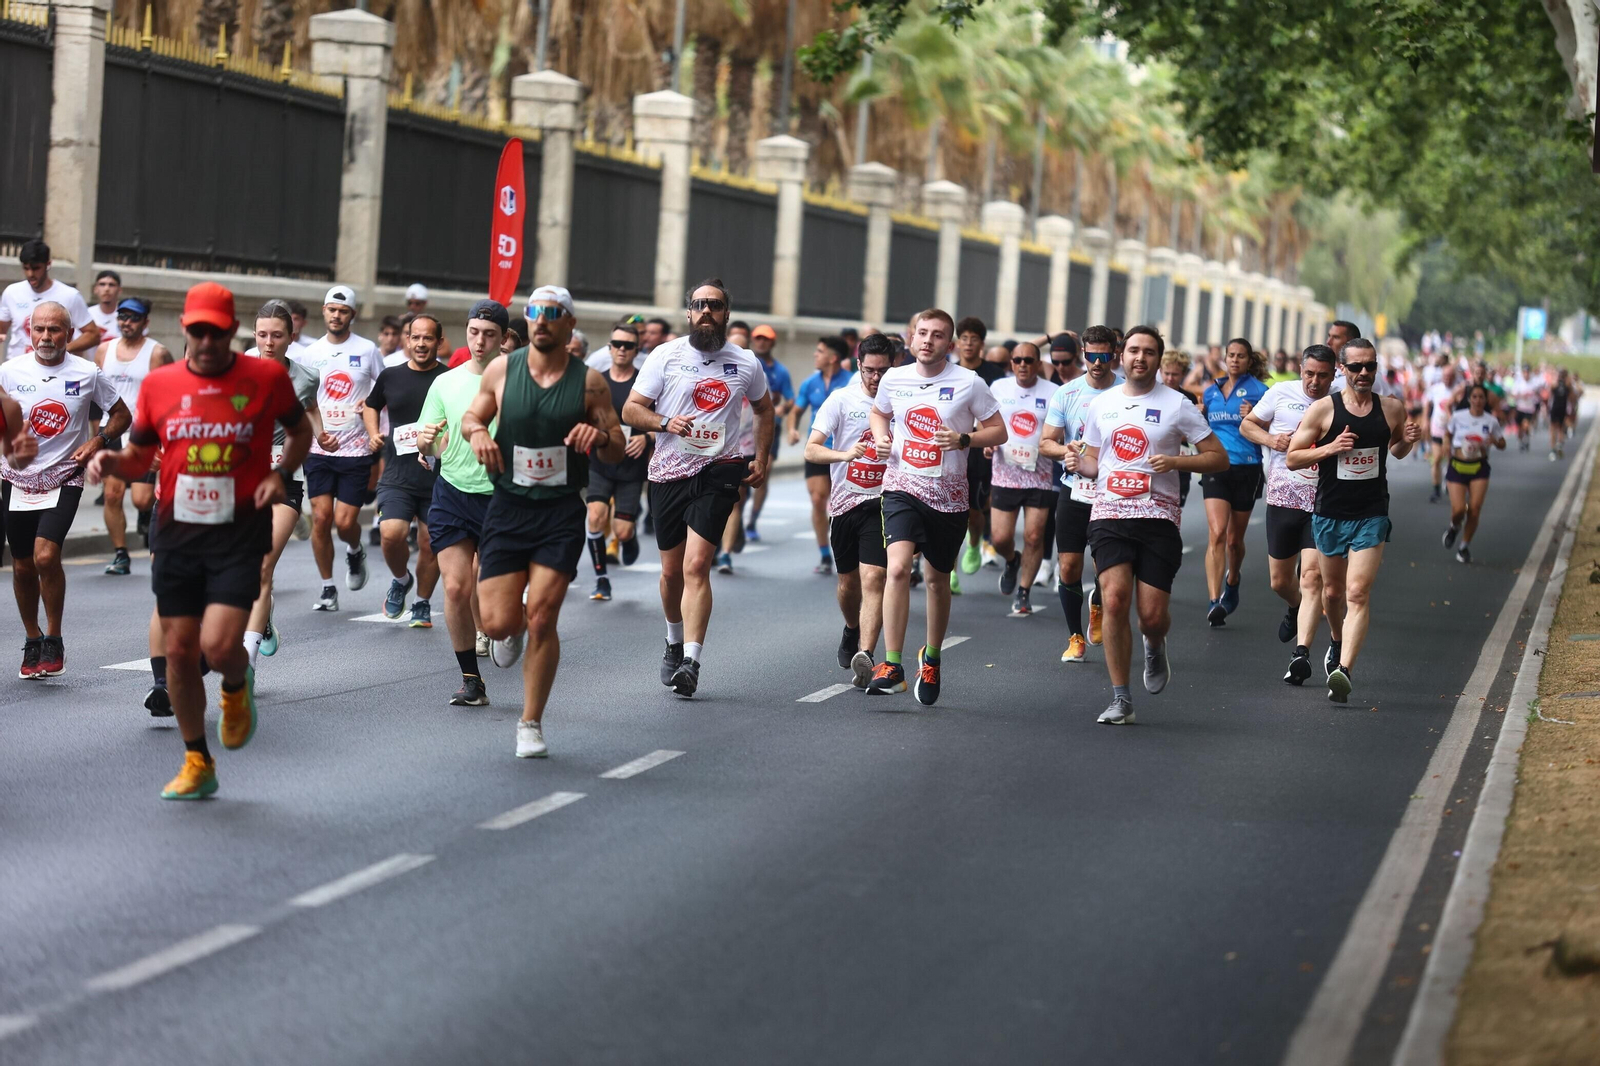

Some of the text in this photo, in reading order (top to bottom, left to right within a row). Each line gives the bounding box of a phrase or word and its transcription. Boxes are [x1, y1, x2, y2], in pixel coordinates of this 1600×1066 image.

[326, 382, 349, 394] FRENO
[328, 377, 350, 389] PONLE
[699, 384, 727, 399] PONLE
[36, 408, 64, 422] PONLE
[326, 410, 346, 418] 551
[910, 412, 938, 426] PONLE
[34, 416, 62, 430] FRENO
[908, 419, 936, 433] FRENO
[1012, 421, 1033, 433] FRENO
[1014, 415, 1035, 427] PONLE
[685, 429, 719, 440] 1156
[1116, 432, 1144, 447] PONLE
[1011, 449, 1031, 457] 959
[1115, 440, 1141, 454] FRENO
[905, 447, 937, 460] 2606
[527, 458, 553, 469] 141
[1344, 455, 1374, 465] 1265
[851, 468, 883, 480] 2152
[1111, 477, 1144, 489] 2422
[186, 488, 219, 501] 750
